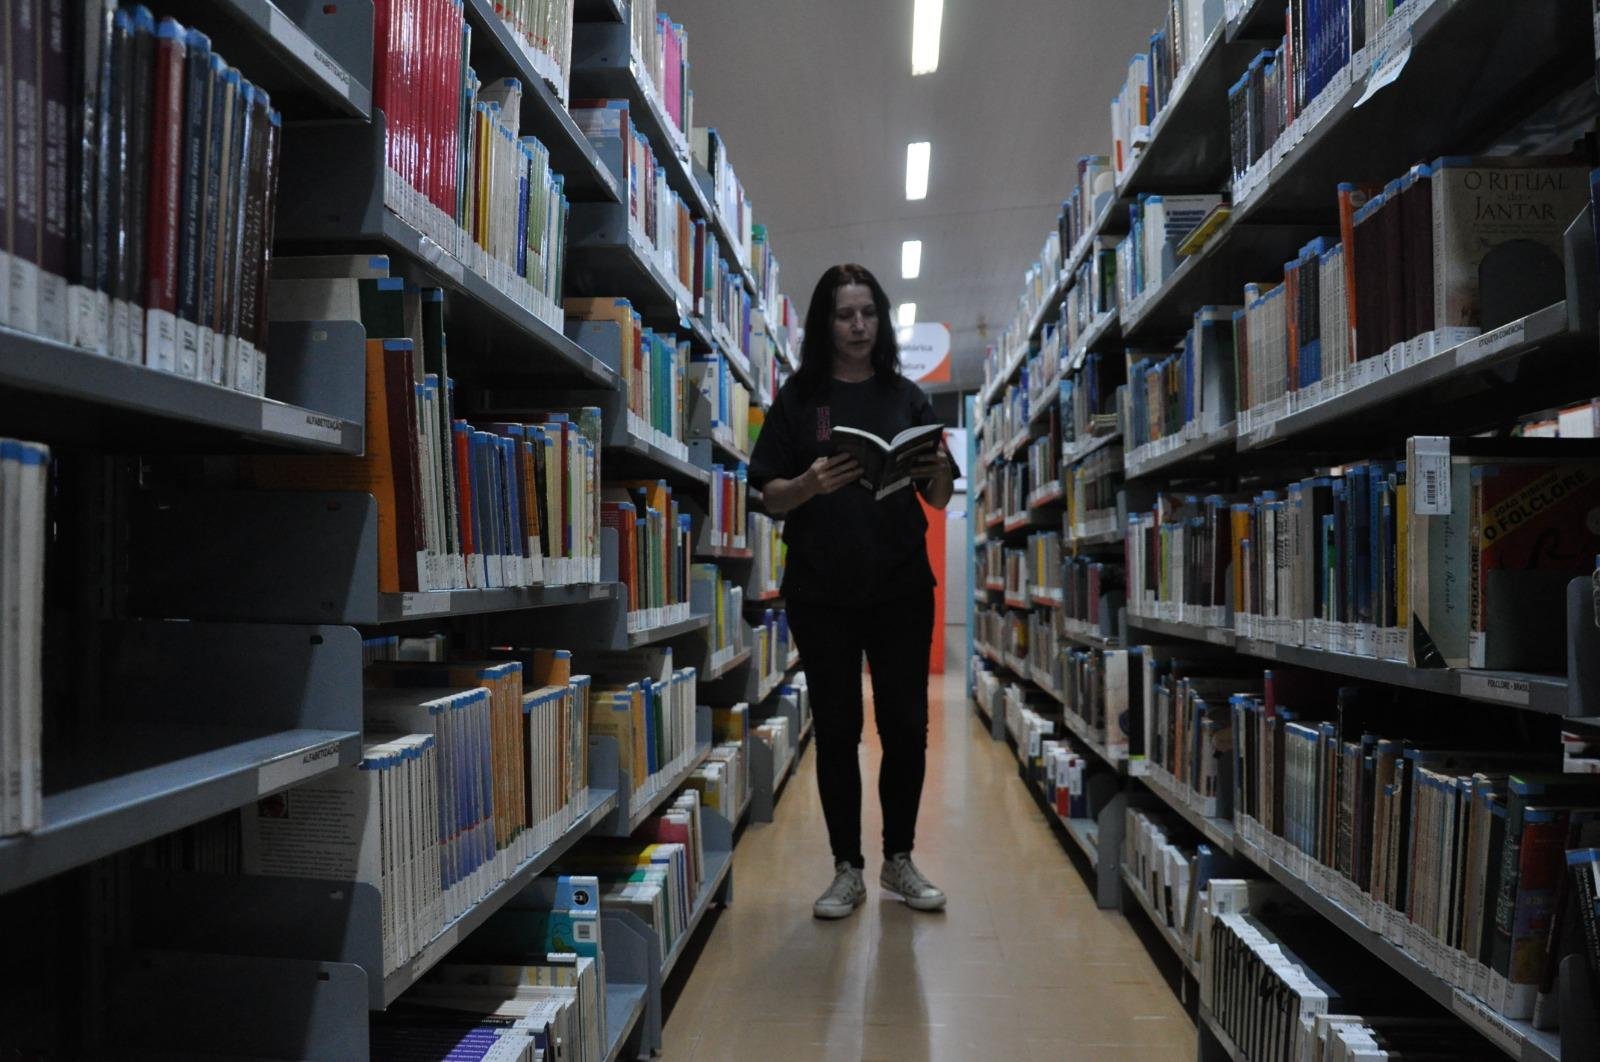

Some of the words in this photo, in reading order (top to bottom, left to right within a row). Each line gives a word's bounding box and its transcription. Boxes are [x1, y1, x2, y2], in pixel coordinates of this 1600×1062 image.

[1464, 171, 1482, 190] O
[1489, 172, 1568, 191] RITUAL
[1474, 196, 1557, 221] JANTAR
[305, 415, 344, 431] ALFABETIZAÇÃO
[1483, 526, 1497, 540] O
[1496, 469, 1587, 532] FOLCLORE
[1471, 545, 1479, 617] FOLCLORE
[1487, 679, 1510, 689] FOLCLORE
[302, 741, 342, 764] ALFABETIZAÇÃO
